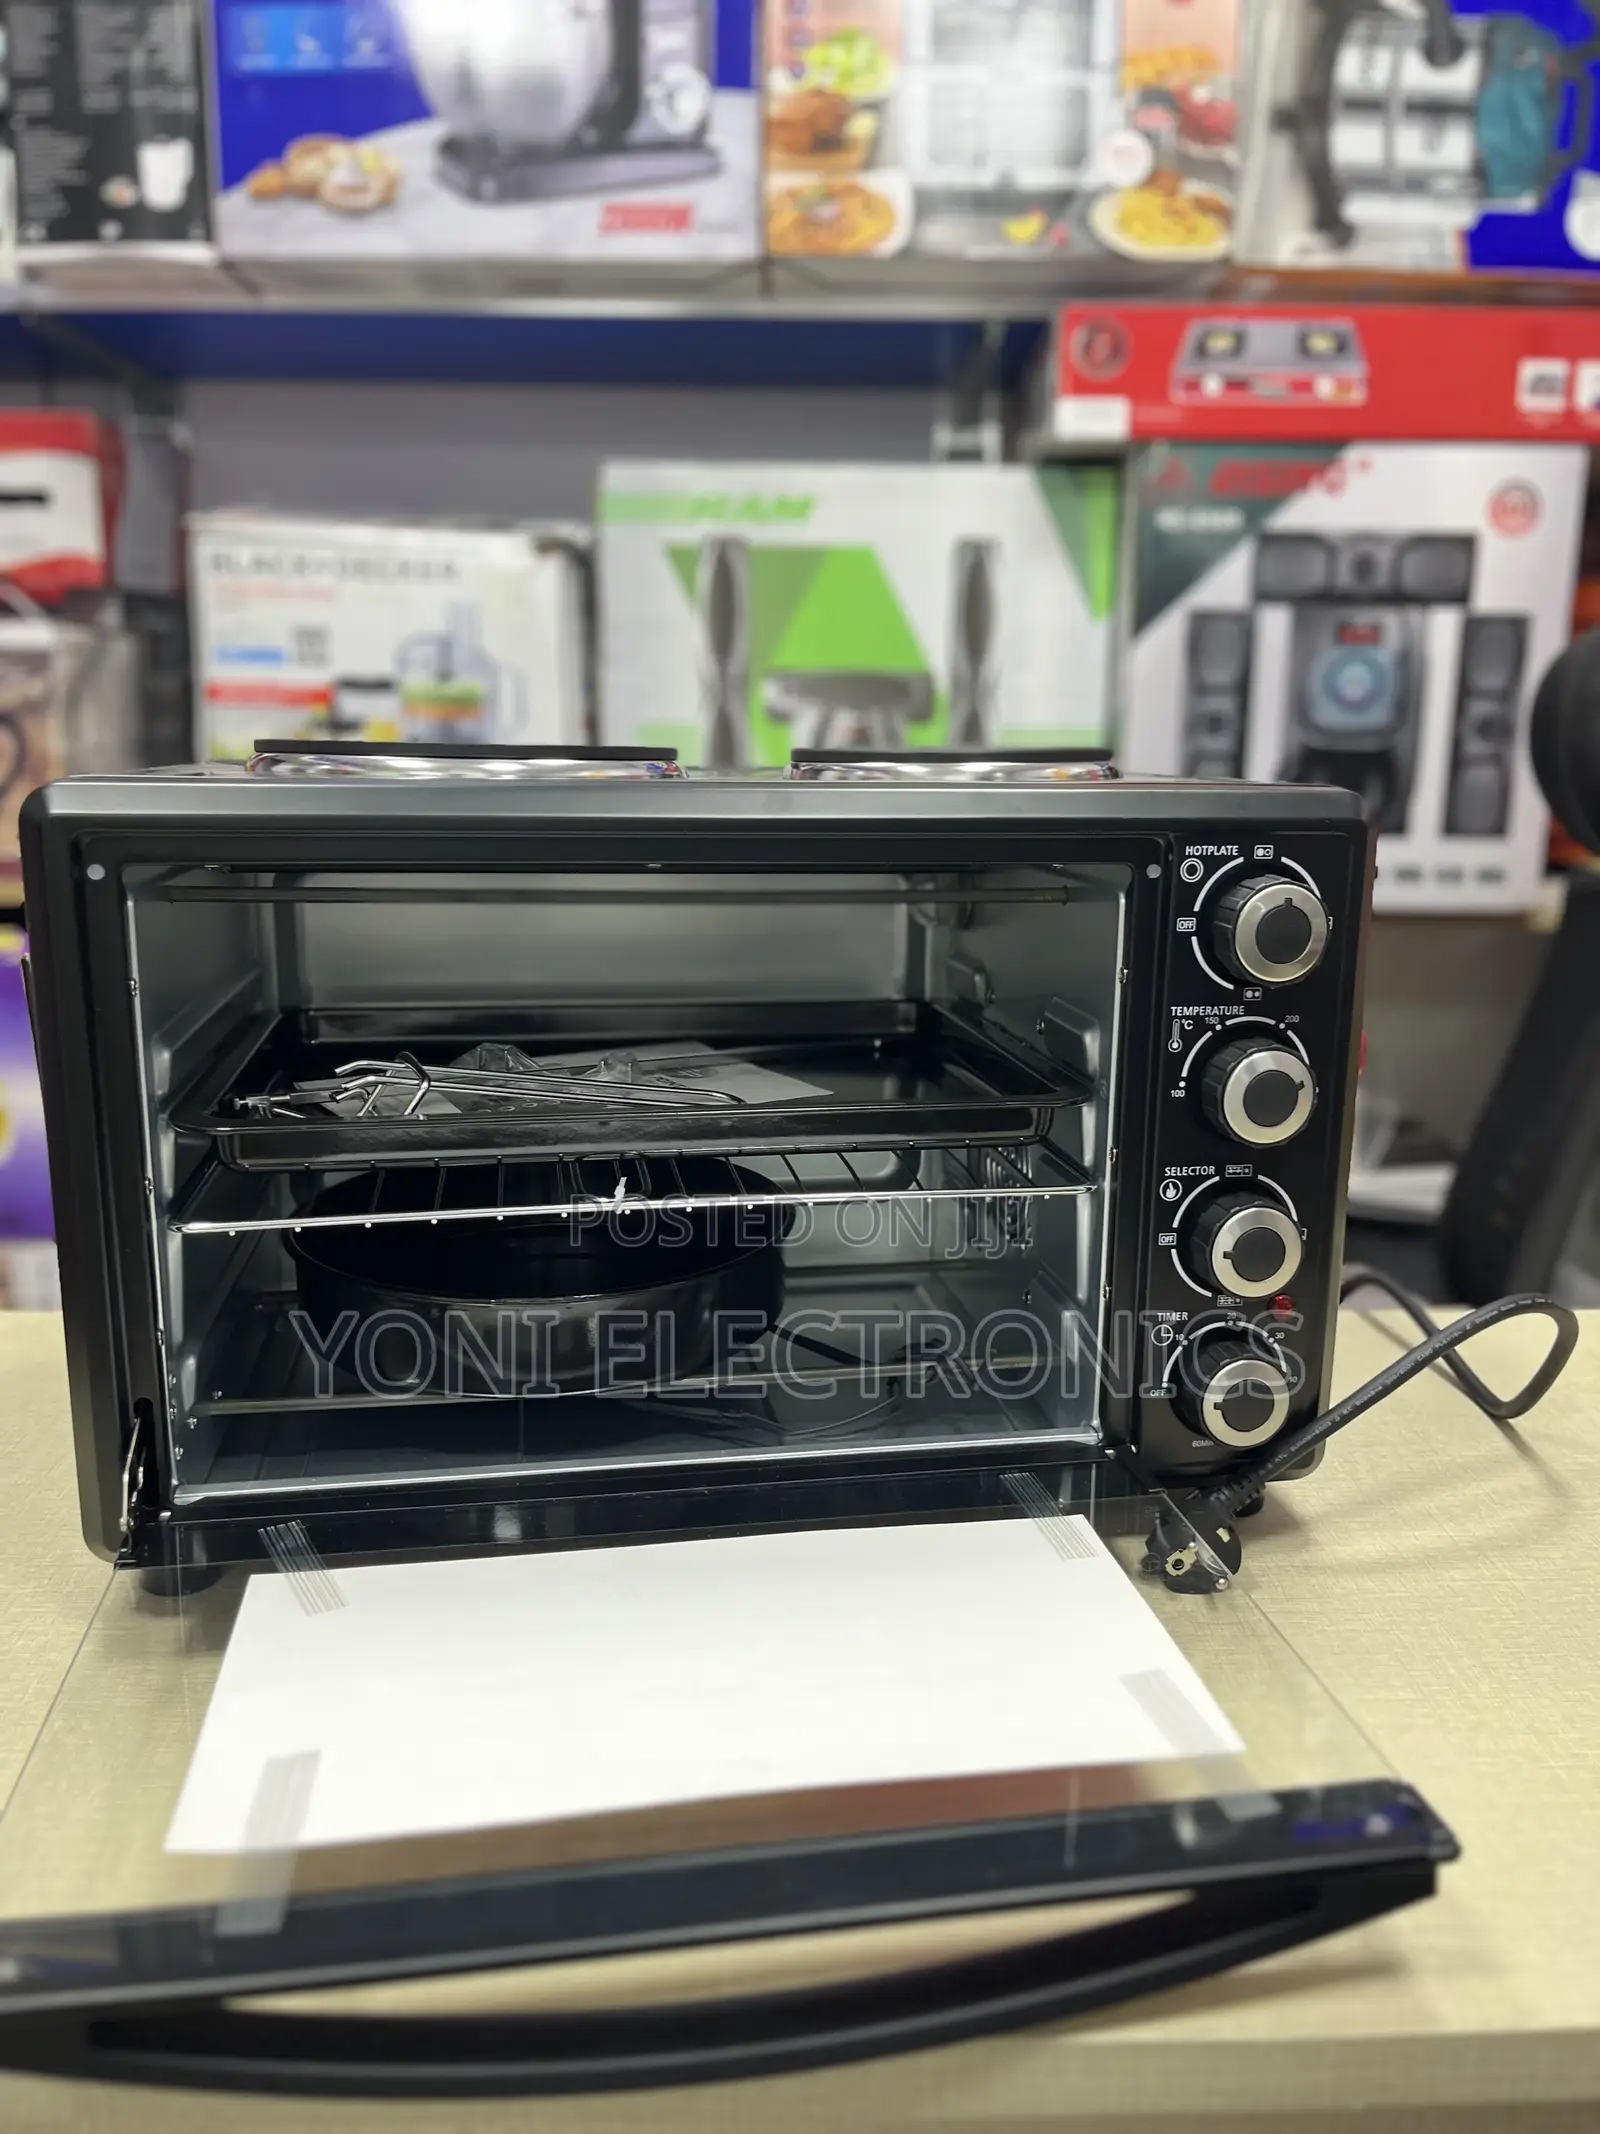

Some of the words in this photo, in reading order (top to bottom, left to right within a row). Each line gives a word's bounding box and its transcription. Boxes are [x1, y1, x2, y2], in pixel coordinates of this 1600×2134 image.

[1185, 845, 1239, 856] HOTPLATE
[1179, 920, 1195, 930] OFF
[1170, 1005, 1245, 1016] TEMPERATURE
[1204, 1016, 1220, 1025] 150
[1284, 1015, 1300, 1023] 200
[1170, 1089, 1186, 1098] 100
[1164, 1165, 1216, 1177] SELECTOR
[1160, 1235, 1174, 1244] OFF
[1157, 1311, 1189, 1322] TIMER
[1226, 1312, 1237, 1320] 20
[1175, 1333, 1185, 1341] 10
[1274, 1331, 1285, 1340] 30
[1149, 1389, 1167, 1397] OFF
